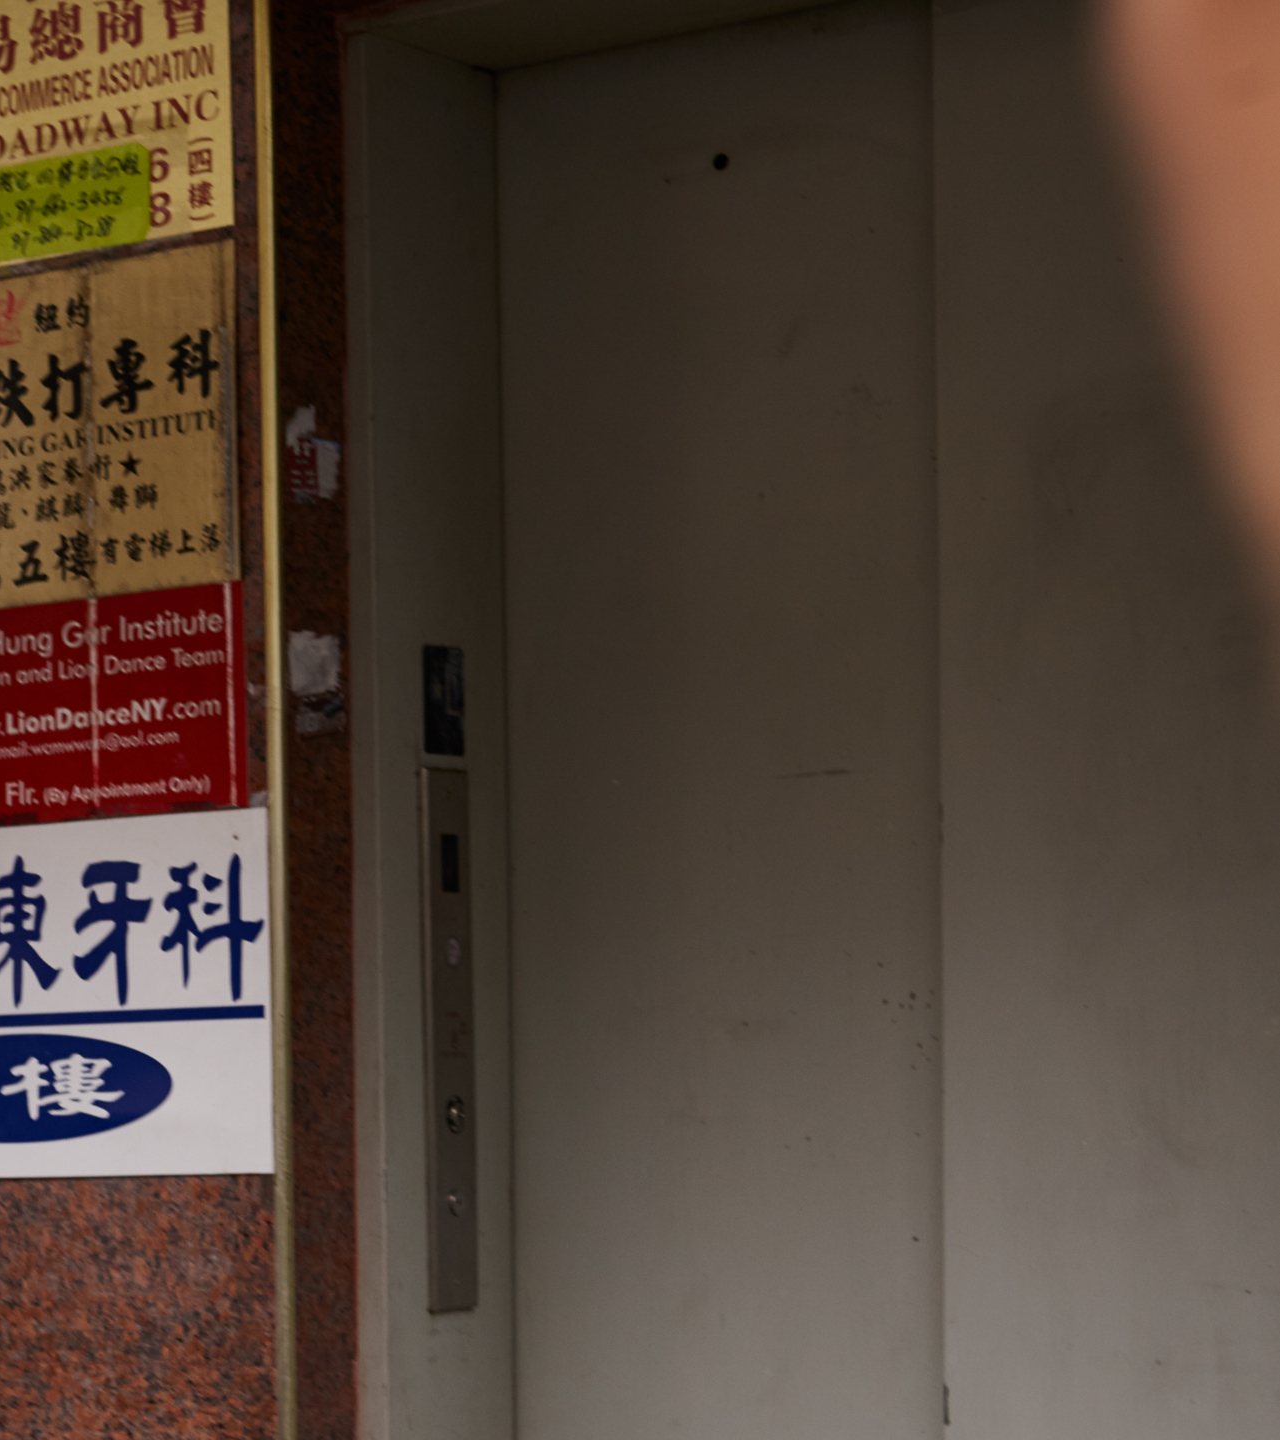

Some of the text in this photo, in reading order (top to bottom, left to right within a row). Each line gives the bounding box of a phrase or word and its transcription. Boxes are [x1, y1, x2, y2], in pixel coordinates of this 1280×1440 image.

[96, 44, 214, 98] ASSOCIATION
[149, 89, 221, 133] INC
[60, 618, 110, 648] Gar
[118, 609, 225, 642] Institute
[15, 660, 54, 685] and
[57, 658, 100, 682] Lion
[103, 652, 168, 676] Dance
[170, 646, 226, 669] Team
[4, 779, 41, 807] Flr.
[42, 787, 70, 808] (By
[70, 778, 168, 806] Appointment
[167, 773, 212, 797] Only)
